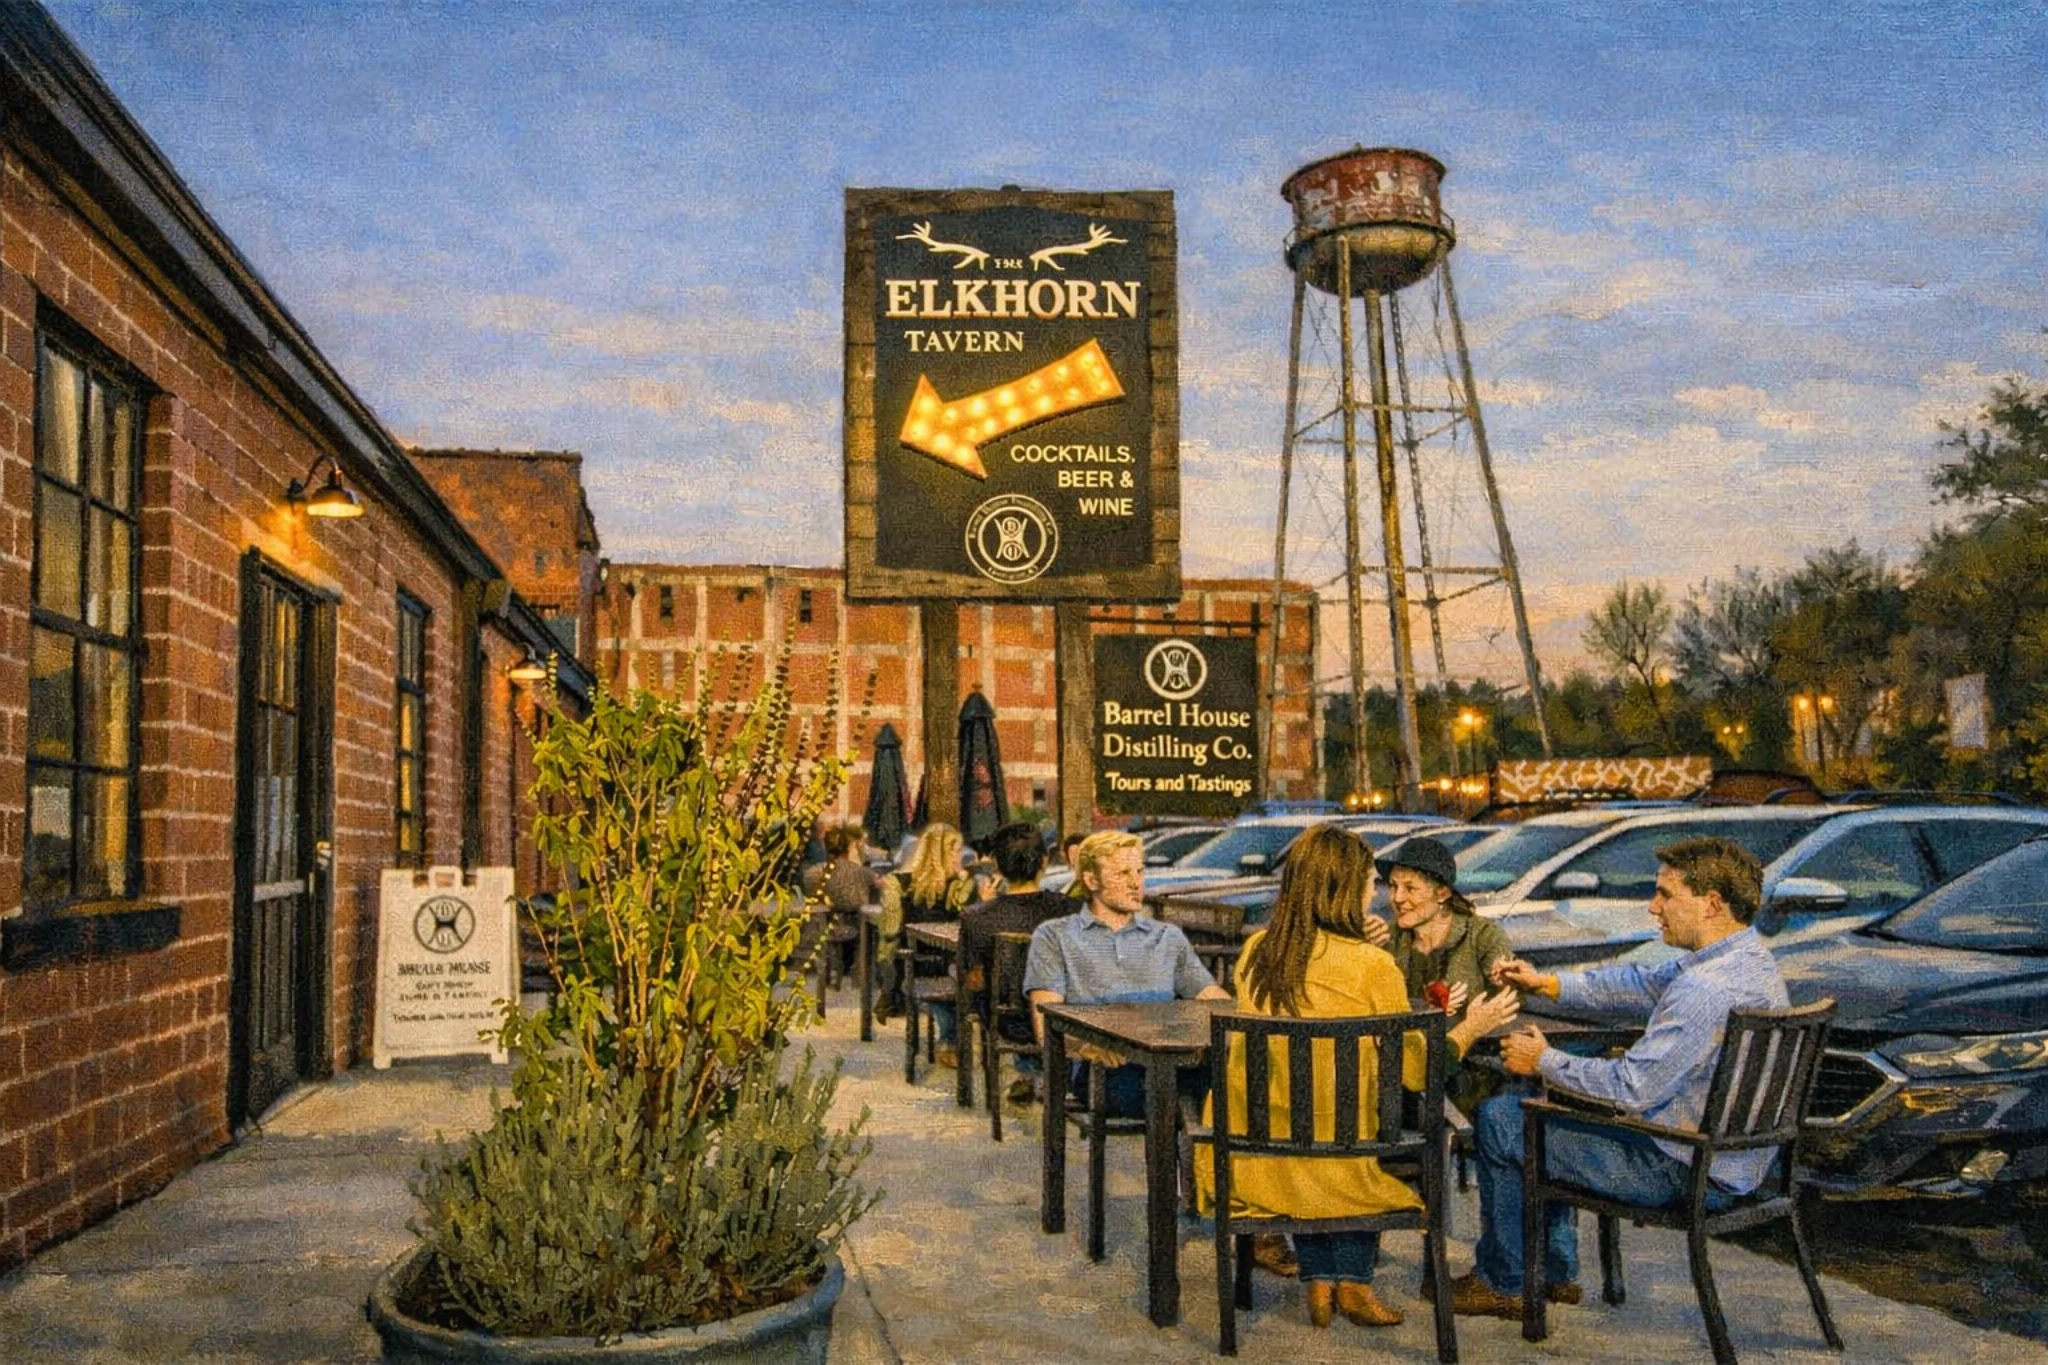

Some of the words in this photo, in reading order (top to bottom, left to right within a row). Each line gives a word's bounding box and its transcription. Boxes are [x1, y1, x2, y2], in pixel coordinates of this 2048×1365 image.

[885, 278, 1141, 319] ELKHORN
[903, 330, 1025, 353] TAVERN
[1058, 470, 1115, 489] BEER
[1119, 471, 1135, 488] &
[1079, 499, 1135, 516] WINE
[1103, 701, 1172, 726] Barrel
[1179, 703, 1251, 728] House
[1103, 733, 1208, 767] Distilling
[1212, 735, 1253, 760] Co.
[1105, 771, 1151, 792] Tours
[1155, 774, 1184, 792] and
[1188, 773, 1252, 798] Tastings
